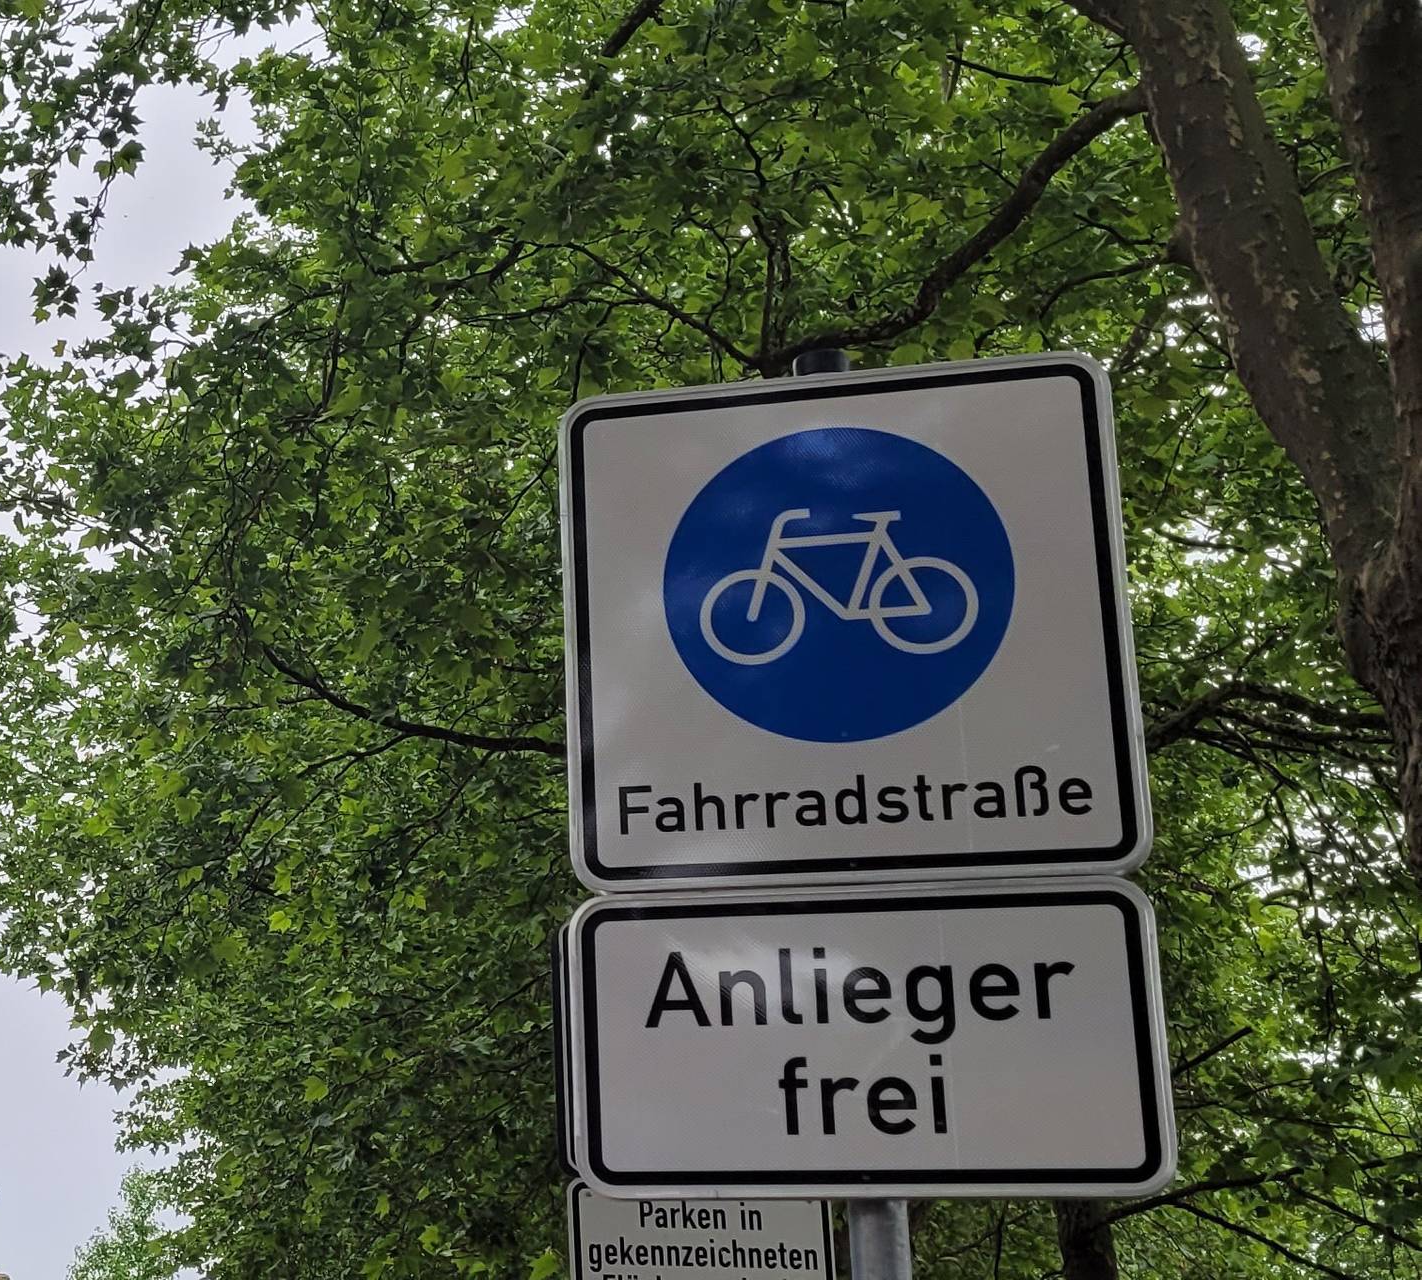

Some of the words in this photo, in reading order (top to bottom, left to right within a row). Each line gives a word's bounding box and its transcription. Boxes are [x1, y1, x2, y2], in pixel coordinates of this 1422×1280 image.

[619, 765, 1093, 835] Fahrradstraße
[644, 947, 1076, 1044] Anlieger
[778, 1054, 949, 1136] frei
[639, 1200, 727, 1230] Parken
[740, 1202, 763, 1231] in
[588, 1236, 819, 1272] gekennzeichneten
